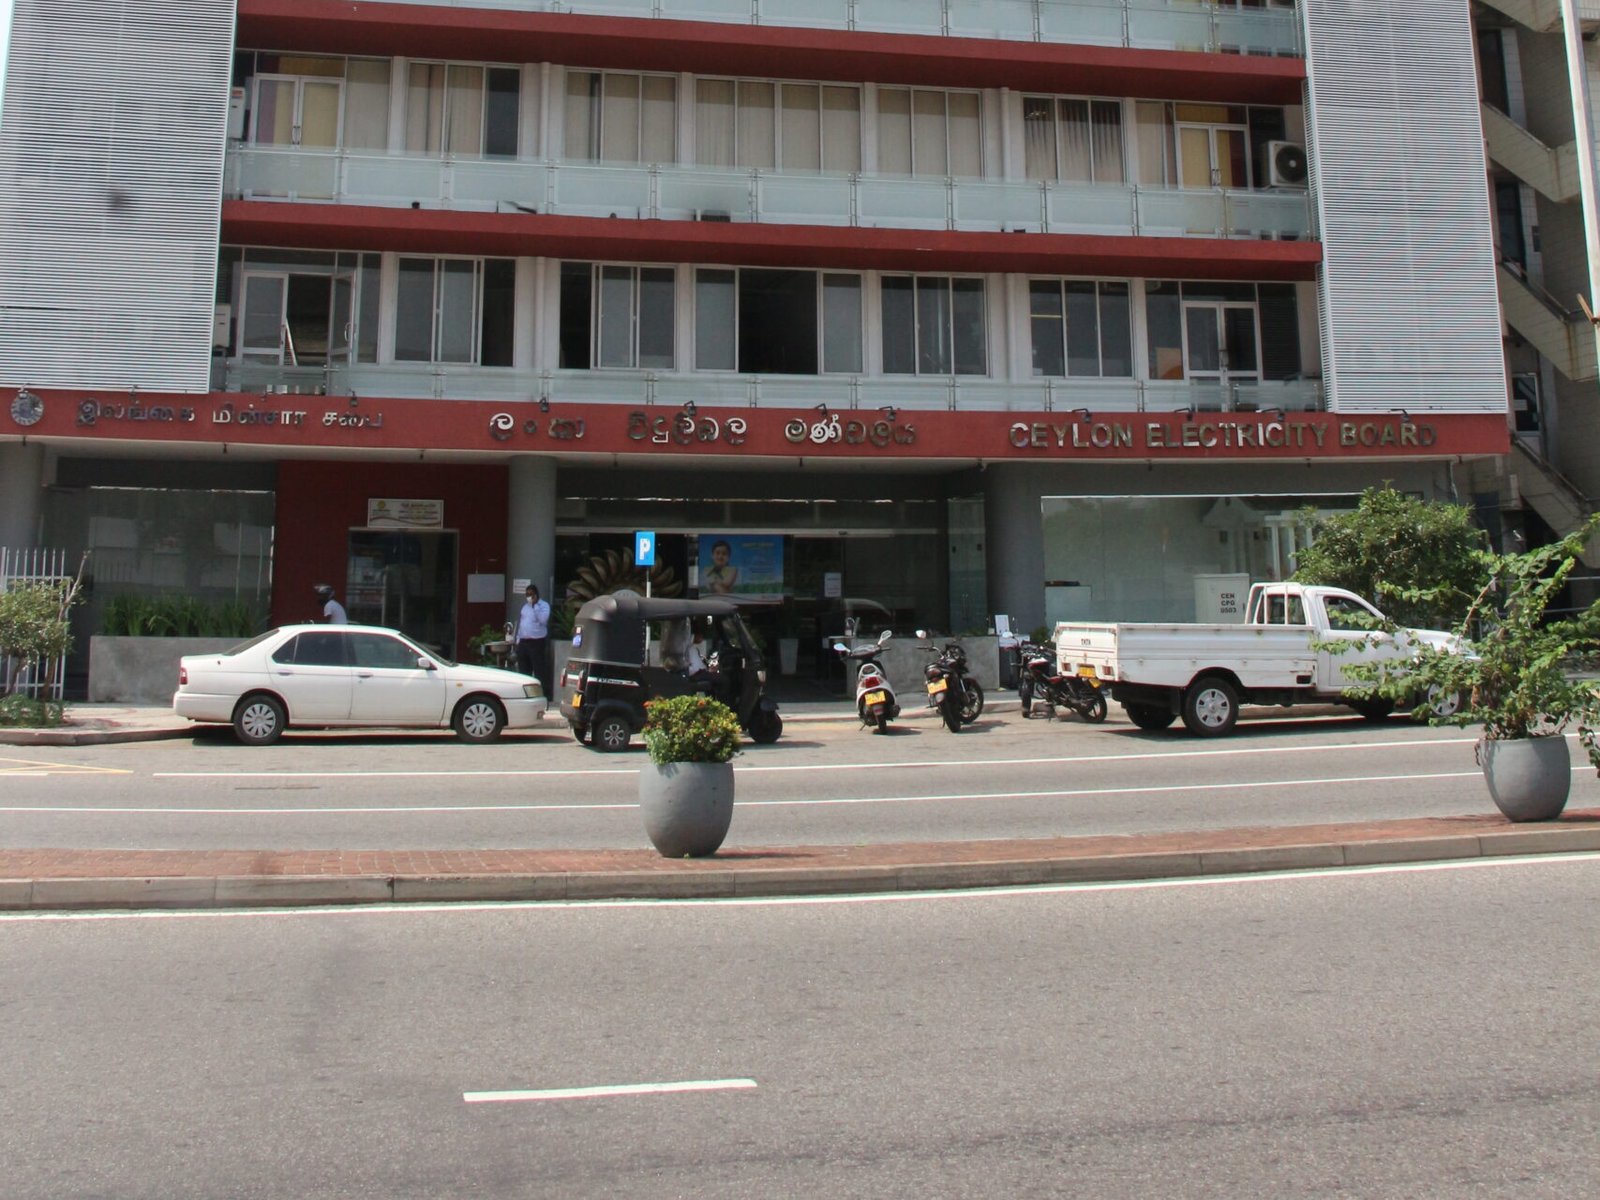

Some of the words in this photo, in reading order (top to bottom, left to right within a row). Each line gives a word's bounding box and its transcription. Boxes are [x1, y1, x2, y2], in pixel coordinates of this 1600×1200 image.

[1009, 422, 1133, 448] CEYLON
[1146, 422, 1329, 448] ELECTRICITY
[1339, 422, 1437, 447] BOARD
[640, 538, 651, 560] P
